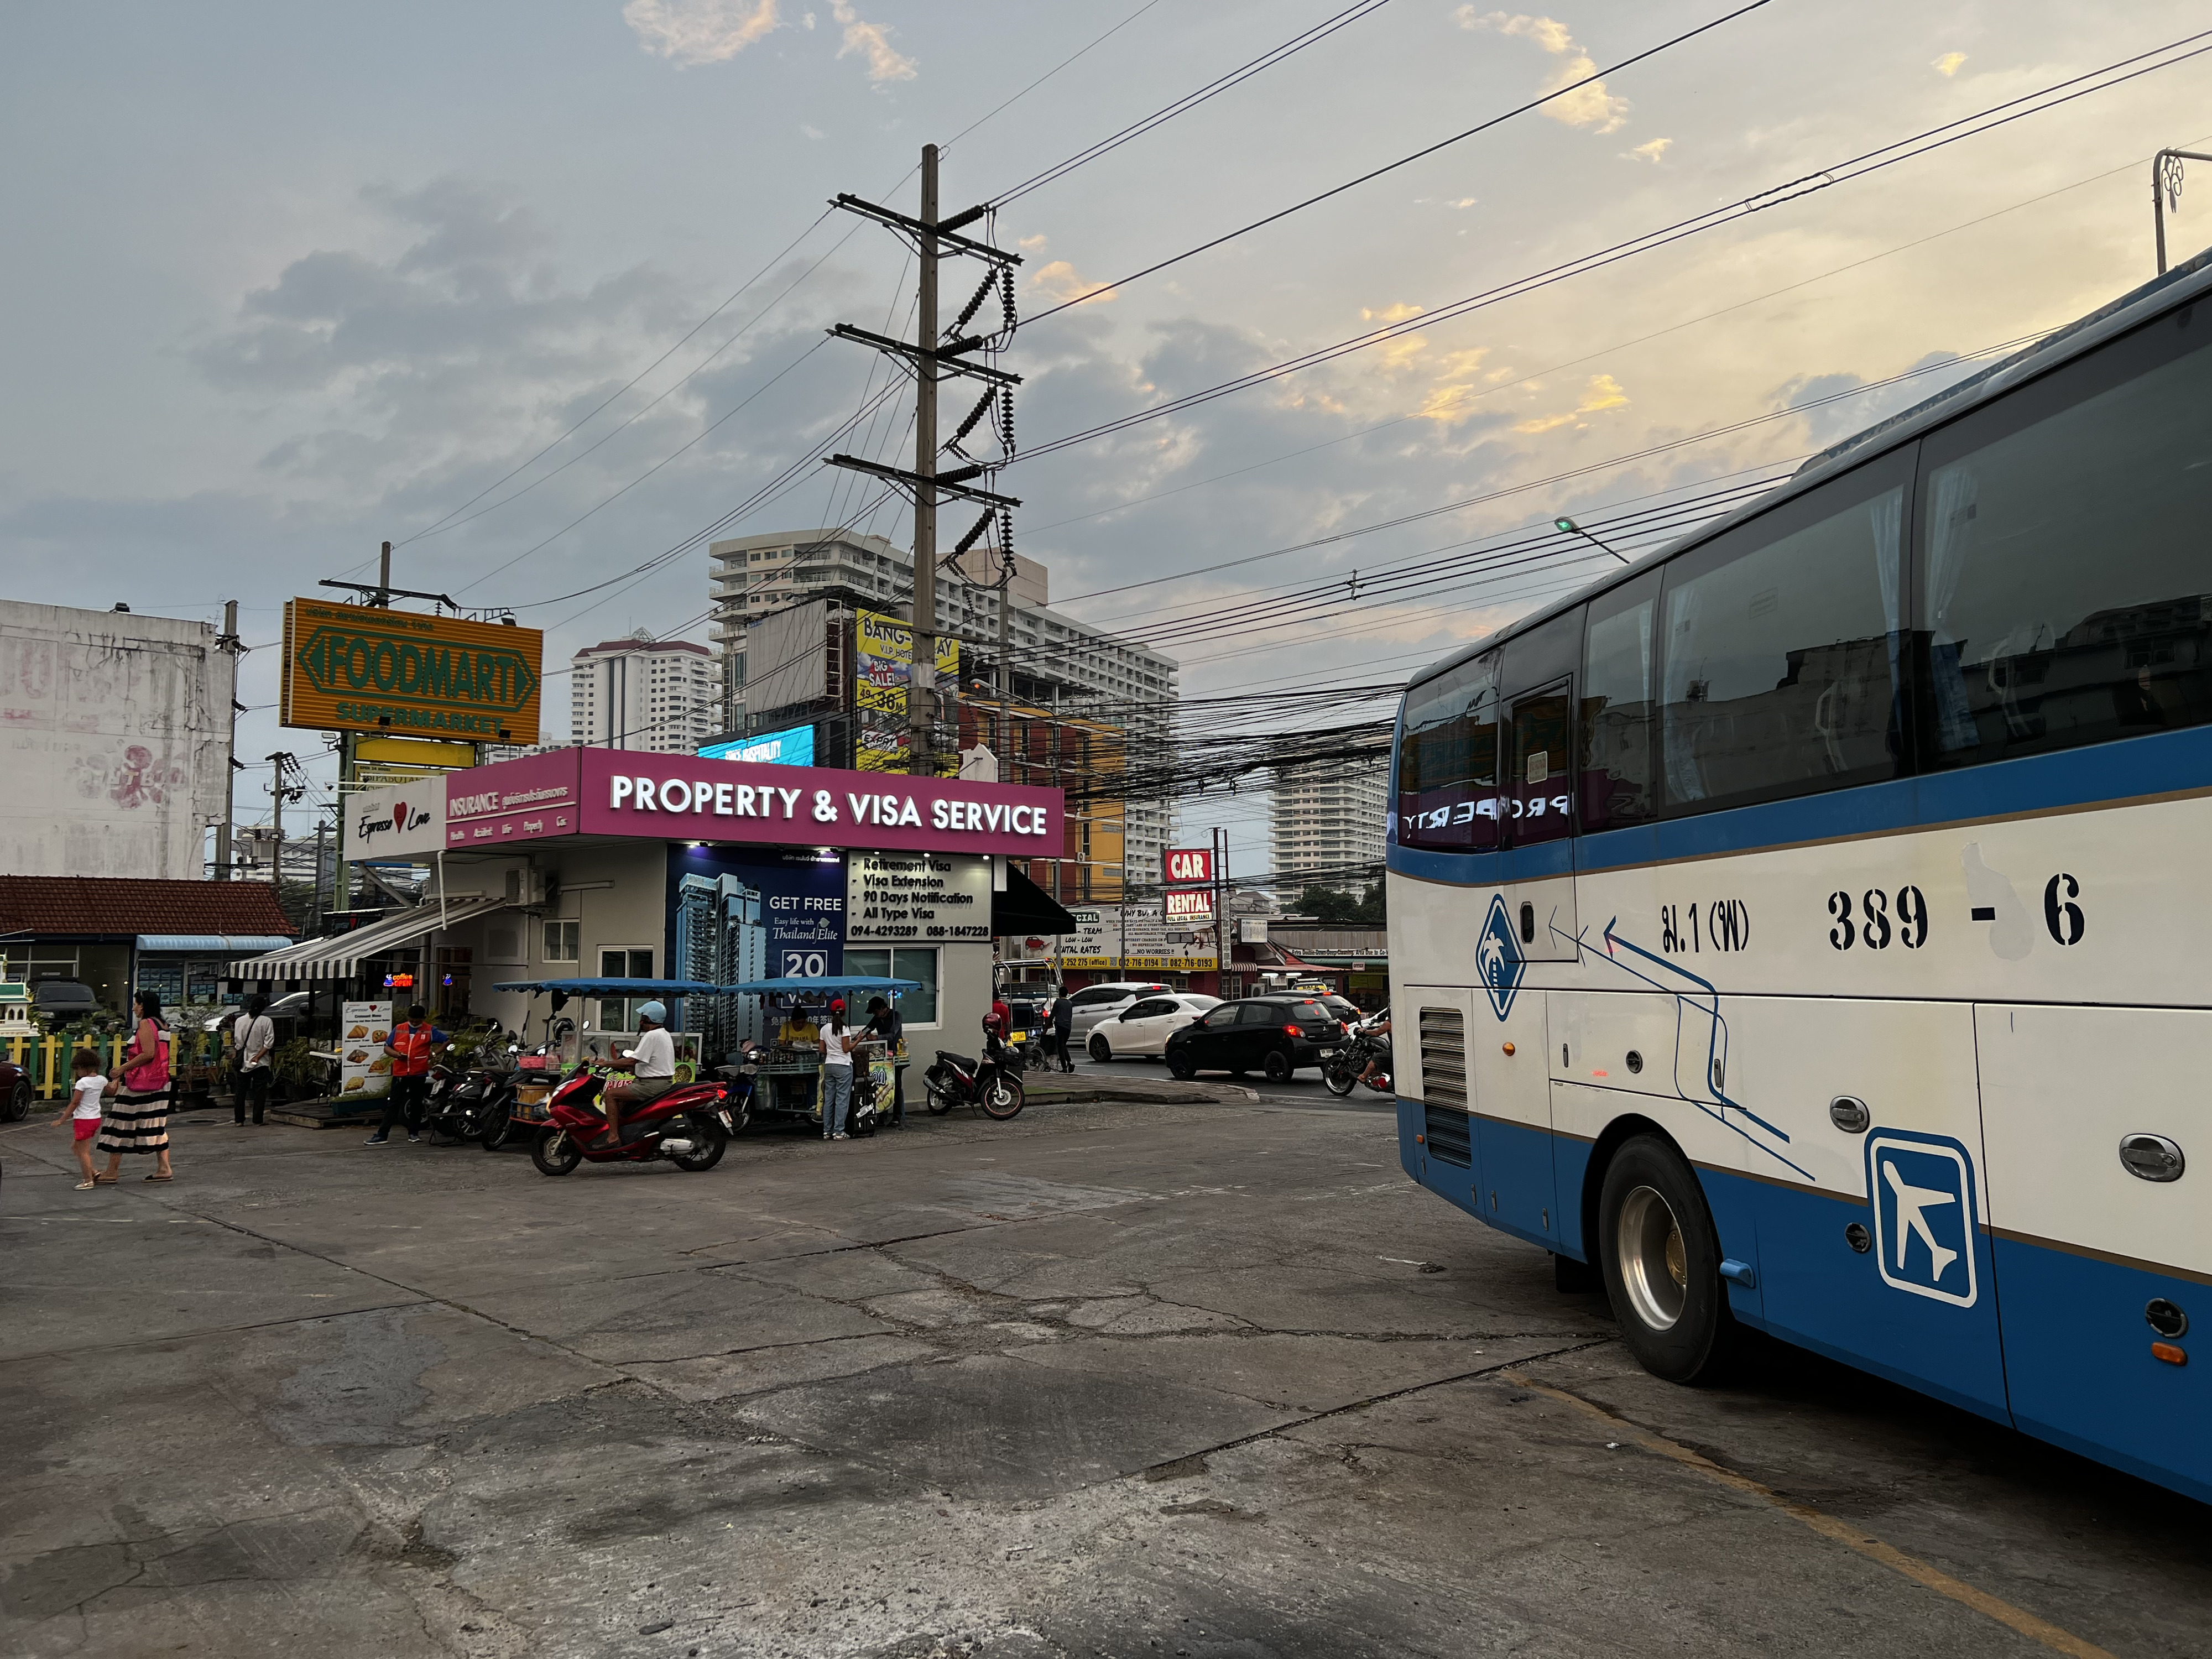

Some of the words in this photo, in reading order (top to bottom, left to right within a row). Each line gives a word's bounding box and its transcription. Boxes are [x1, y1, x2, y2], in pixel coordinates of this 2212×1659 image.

[896, 648, 912, 660] HOTE
[329, 635, 514, 702] FOODMART
[874, 660, 888, 672] BIG
[869, 672, 895, 687] SALE!
[877, 691, 895, 710] 36
[336, 702, 504, 734] SUPERMARKET
[450, 791, 499, 817] INSURANCE
[611, 775, 802, 820] PROPERTY
[812, 790, 838, 822] &
[846, 792, 922, 827] VISA
[931, 800, 1047, 835] SERVICE
[358, 815, 393, 844] Espresso
[408, 807, 430, 831] Love
[864, 858, 926, 872] Retirement
[928, 859, 951, 872] Visa
[1171, 854, 1204, 879] CAR
[863, 874, 888, 886] Visa
[891, 875, 944, 888] Extension
[769, 896, 800, 910] GET
[804, 898, 842, 911] FREE
[864, 890, 877, 902] 90
[880, 891, 909, 905] Days
[911, 891, 973, 904] Notification
[1167, 893, 1210, 914] RENTAL
[863, 907, 878, 919] All
[881, 907, 909, 921] Type
[911, 907, 935, 919] Visa
[1072, 914, 1098, 922] CIAL
[1828, 885, 1929, 951] 389
[2044, 873, 2085, 946] 6
[774, 917, 789, 927] Easy
[773, 927, 816, 940] Thailand
[817, 928, 838, 940] Elite
[851, 925, 918, 936] 094-4293289
[926, 926, 989, 936] 088-1847228
[1080, 945, 1102, 954] RATES
[786, 953, 825, 978] 20
[1089, 957, 1107, 966] (office)
[1170, 958, 1212, 967] 082-716-0193
